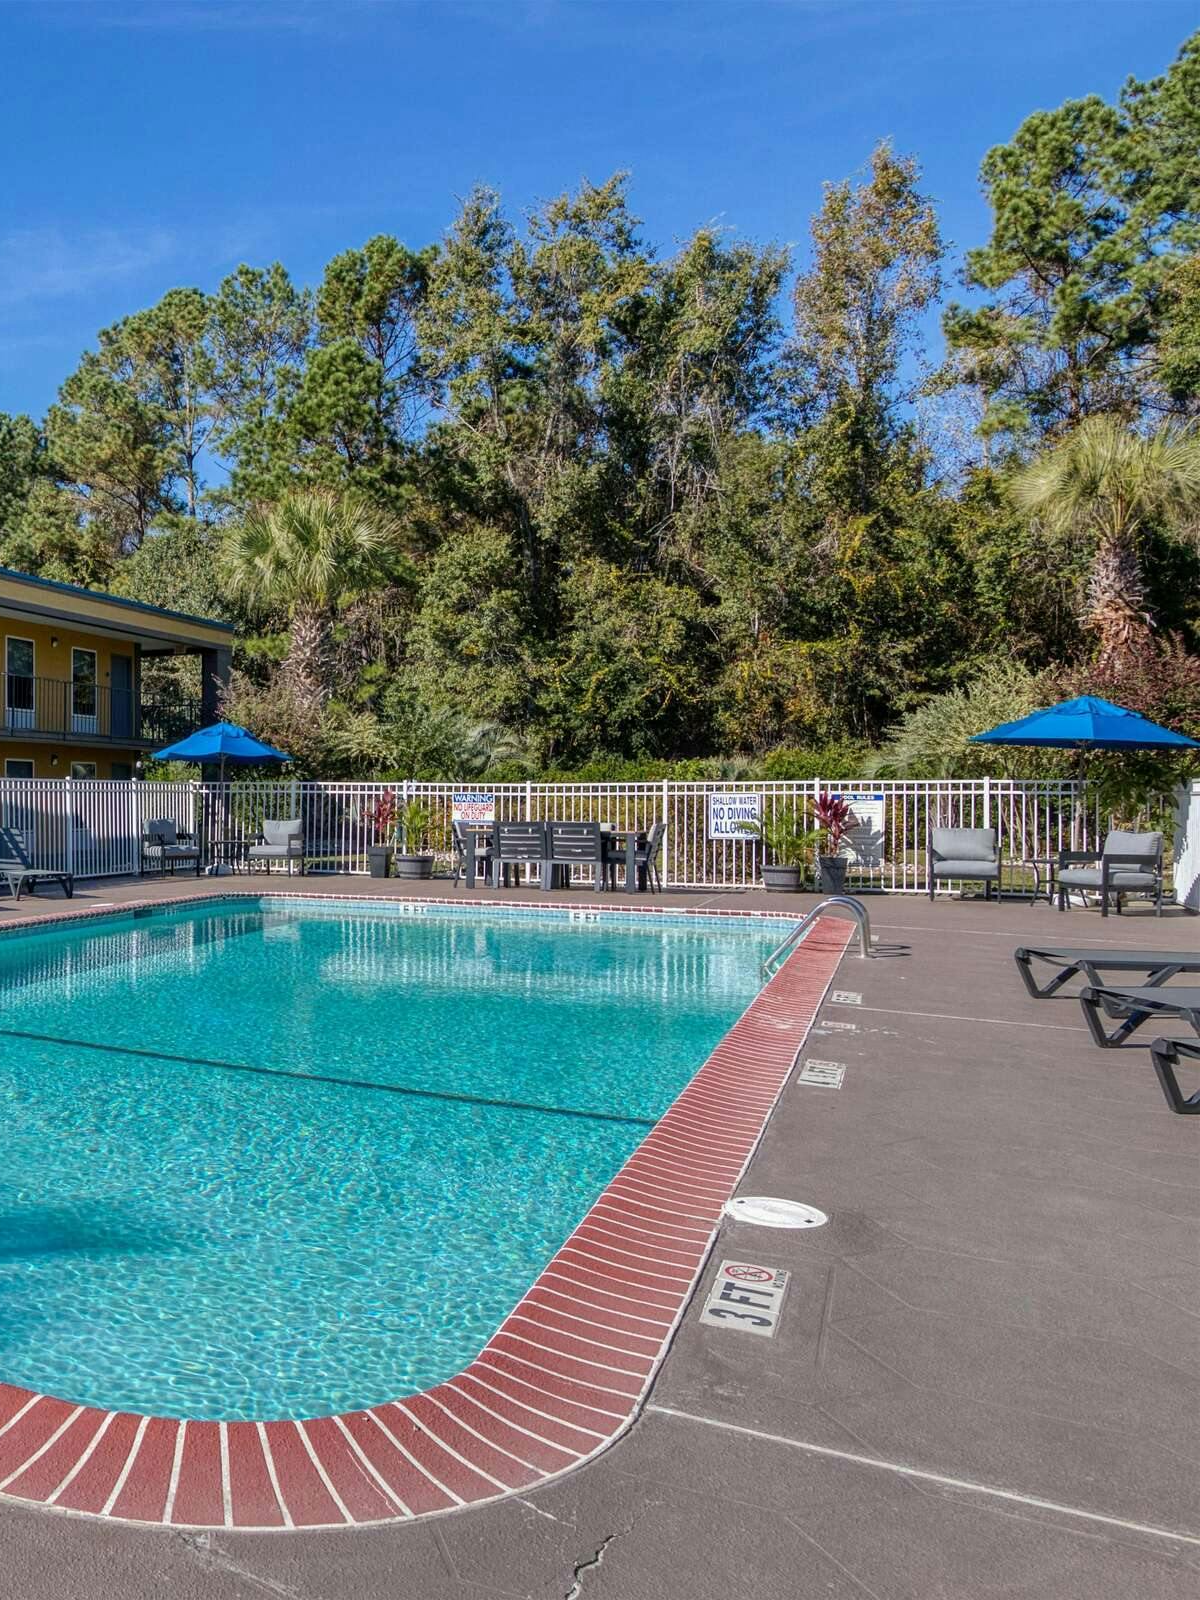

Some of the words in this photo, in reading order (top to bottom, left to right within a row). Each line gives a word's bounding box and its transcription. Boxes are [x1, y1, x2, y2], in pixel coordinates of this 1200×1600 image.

[454, 794, 493, 802] WARNING
[712, 796, 737, 806] SHALLOW
[738, 796, 756, 806] WATER
[454, 803, 462, 811] NO
[464, 803, 493, 811] LIFEGUARD
[461, 811, 470, 819] ON
[471, 811, 485, 819] DUTY
[712, 807, 725, 820] NO
[727, 807, 757, 820] DIVING
[720, 1281, 775, 1309] FT
[708, 1308, 773, 1327] 3
